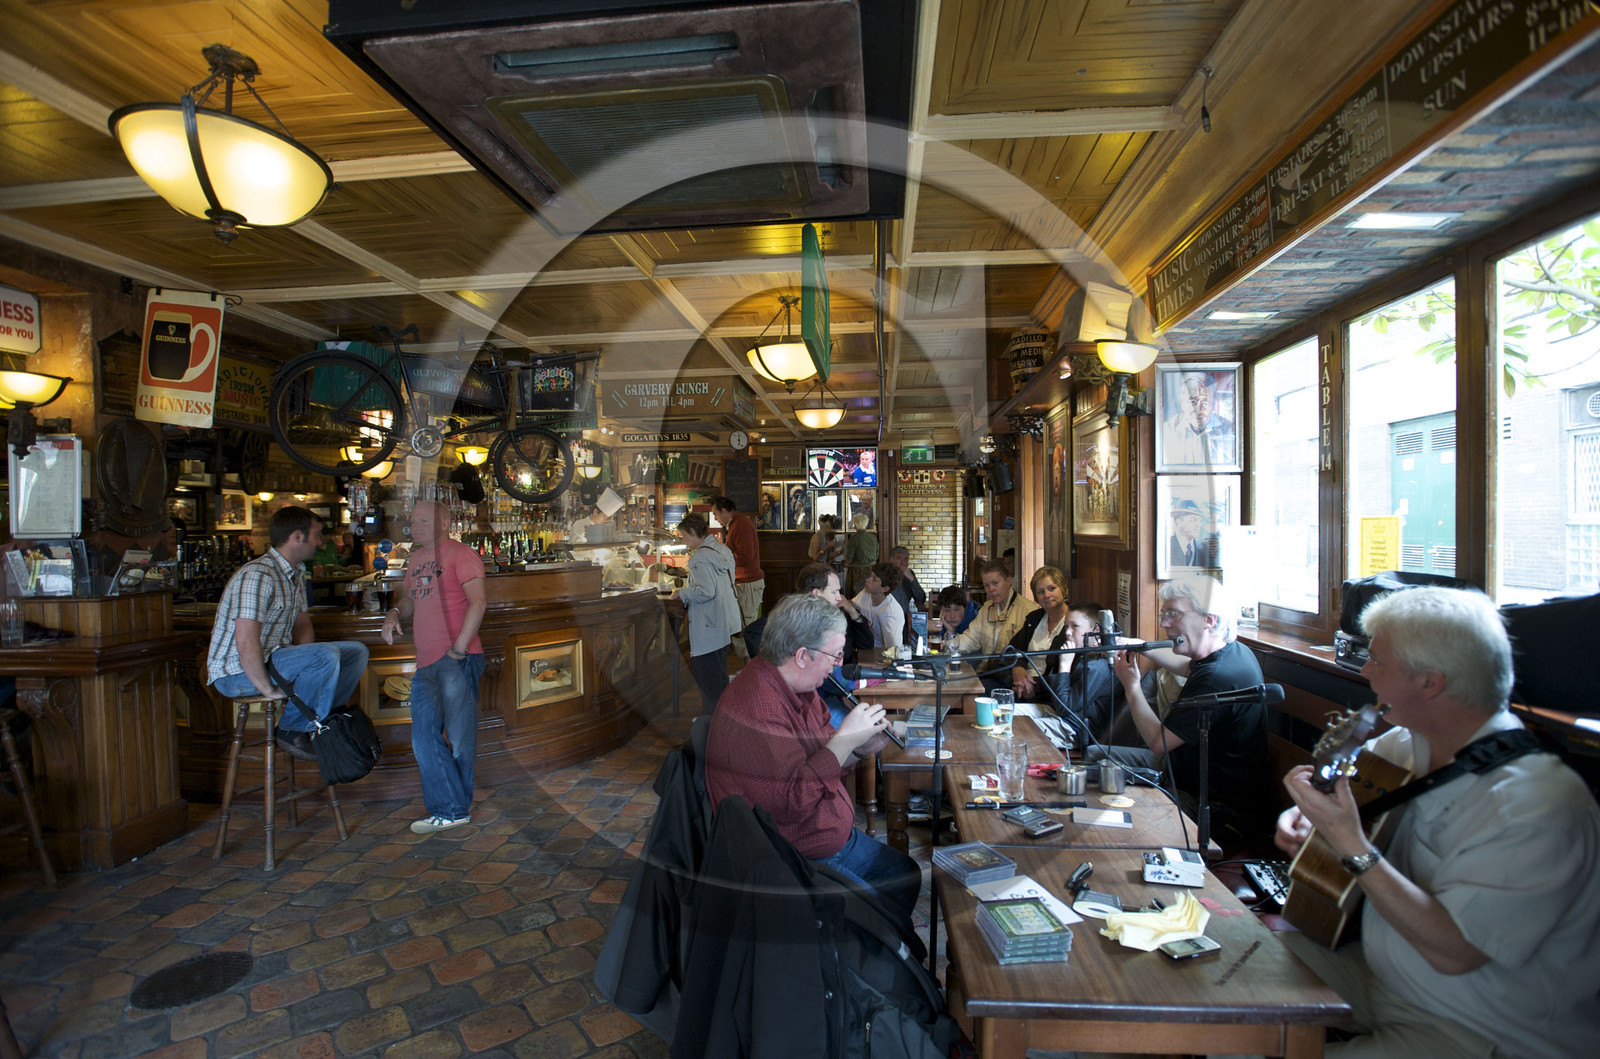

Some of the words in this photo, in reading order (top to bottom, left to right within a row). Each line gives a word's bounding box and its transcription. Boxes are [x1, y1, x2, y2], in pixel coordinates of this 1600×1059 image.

[1420, 0, 1515, 84] UPSTAIRS
[1424, 69, 1468, 119] SUN
[1270, 134, 1321, 188] UPSTAIRS
[1276, 169, 1325, 221] FRI-SAT
[1198, 203, 1242, 249] DOWNSTAIRS
[1193, 219, 1244, 268] MON-THURS
[1153, 248, 1192, 299] MUSIC
[1202, 248, 1234, 280] UPSTAIRS
[1155, 278, 1194, 322] TIMES
[15, 328, 34, 340] YOU
[155, 334, 187, 344] GUINNESS
[223, 389, 262, 407] MUSIC
[229, 379, 256, 395] IRISH
[624, 384, 672, 396] CARVERY
[675, 382, 709, 395] LUNCH
[1320, 343, 1332, 447] TABLE
[138, 394, 212, 416] GUINNESS
[216, 407, 250, 422] UPSTAIRS
[639, 398, 659, 410] 12pm
[678, 397, 695, 408] 4pm
[672, 433, 689, 442] 1835
[1320, 453, 1332, 471] 14
